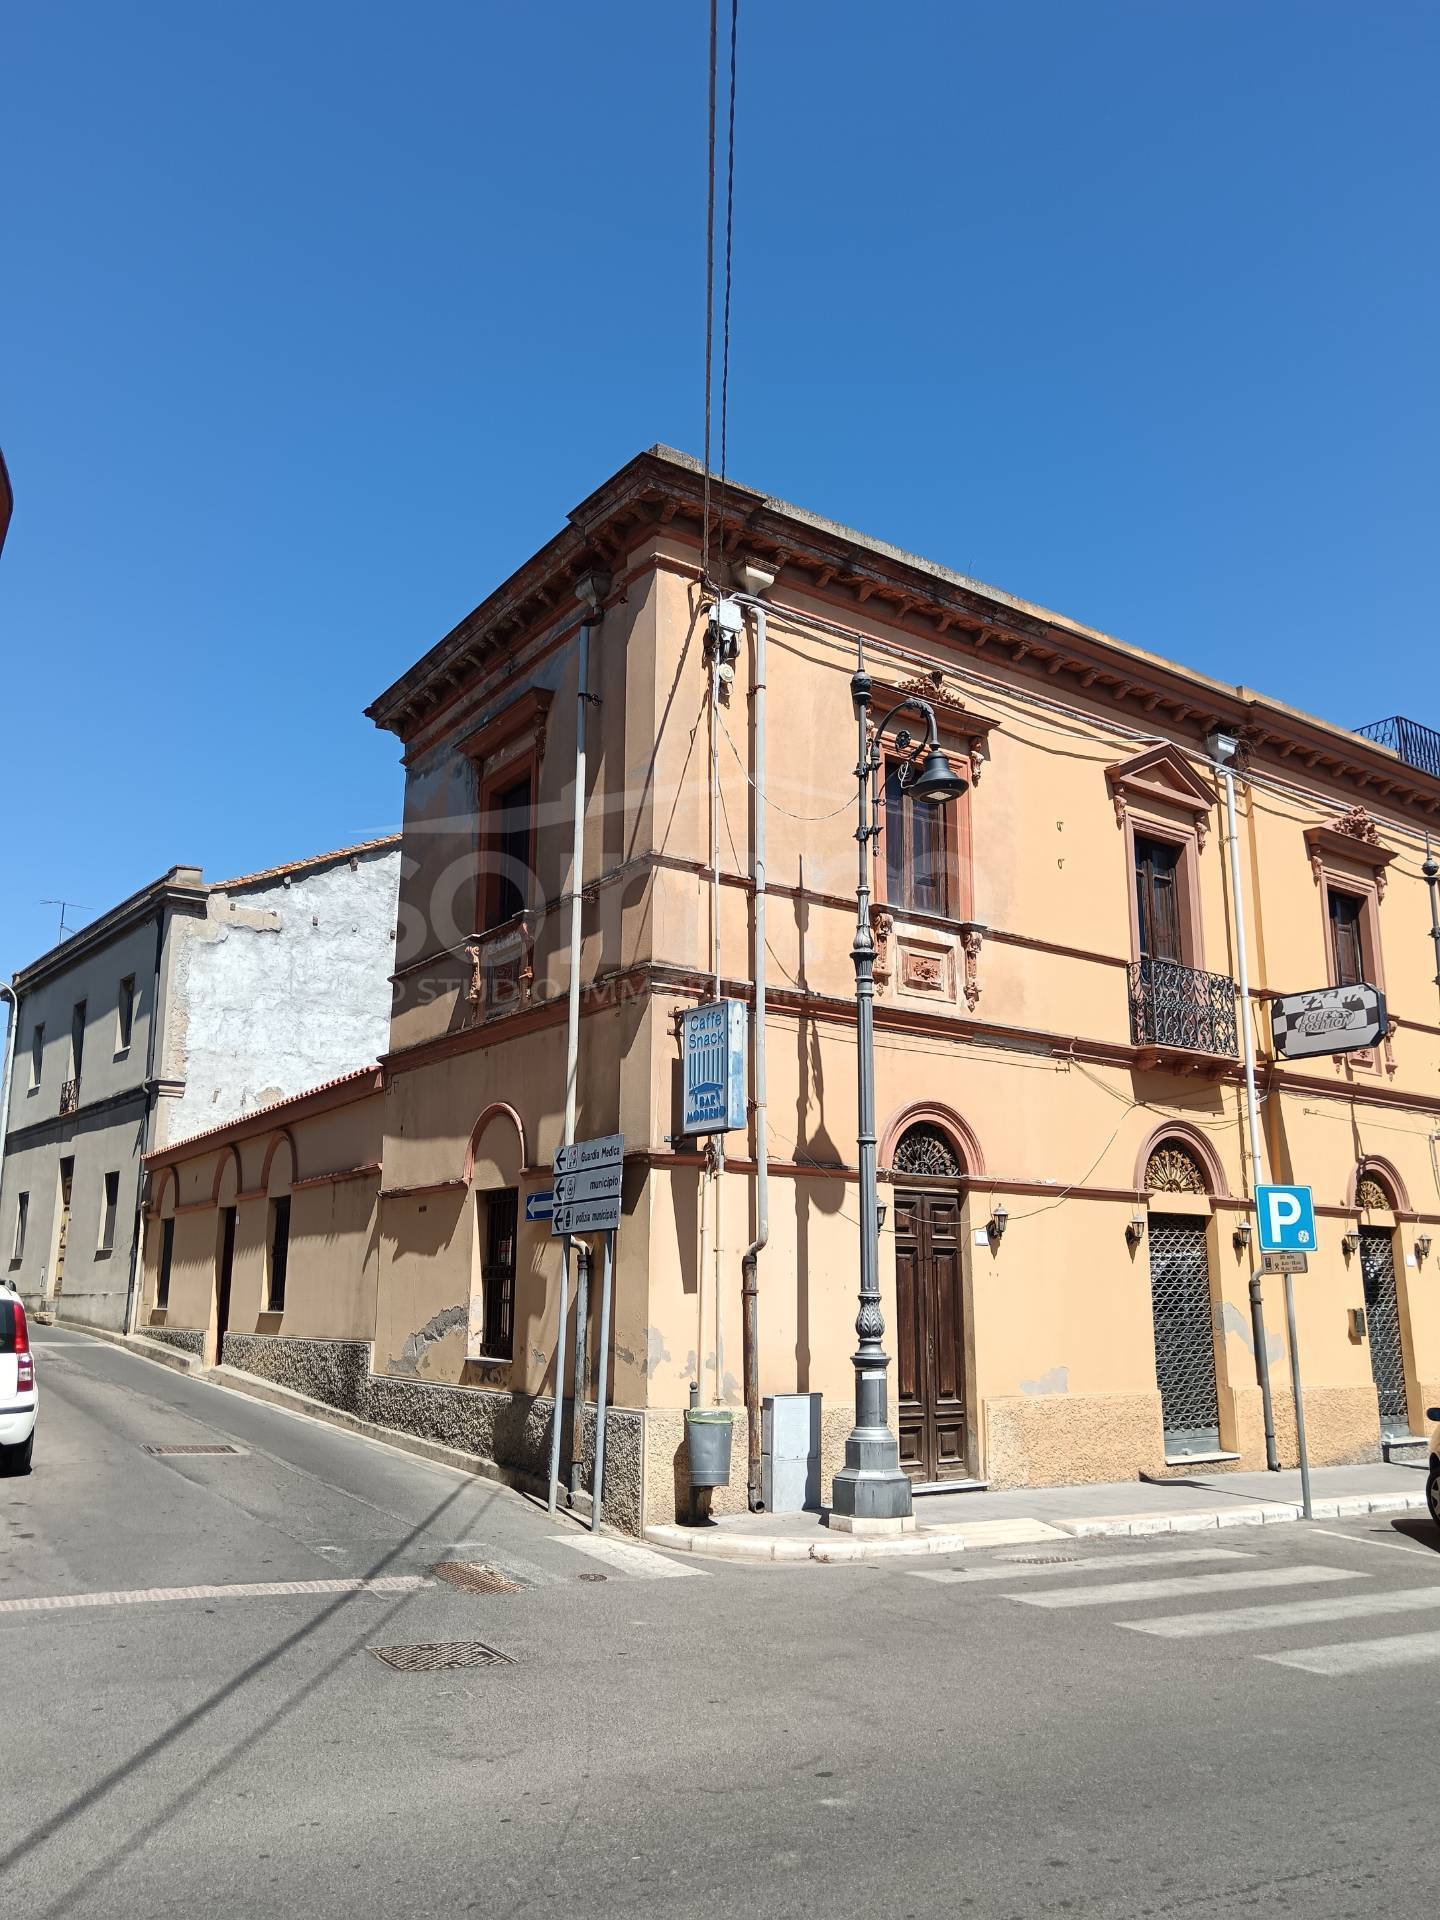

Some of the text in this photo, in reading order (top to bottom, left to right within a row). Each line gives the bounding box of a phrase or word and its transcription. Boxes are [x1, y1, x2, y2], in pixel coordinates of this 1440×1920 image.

[690, 1009, 725, 1031] Caffe'
[689, 1029, 724, 1049] Snack
[700, 1094, 716, 1107] BAR
[686, 1105, 726, 1124] MODERNO
[581, 1145, 620, 1162] Guardia Medica
[589, 1176, 619, 1190] municipio
[591, 1208, 618, 1222] municipale
[1268, 1192, 1302, 1243] P
